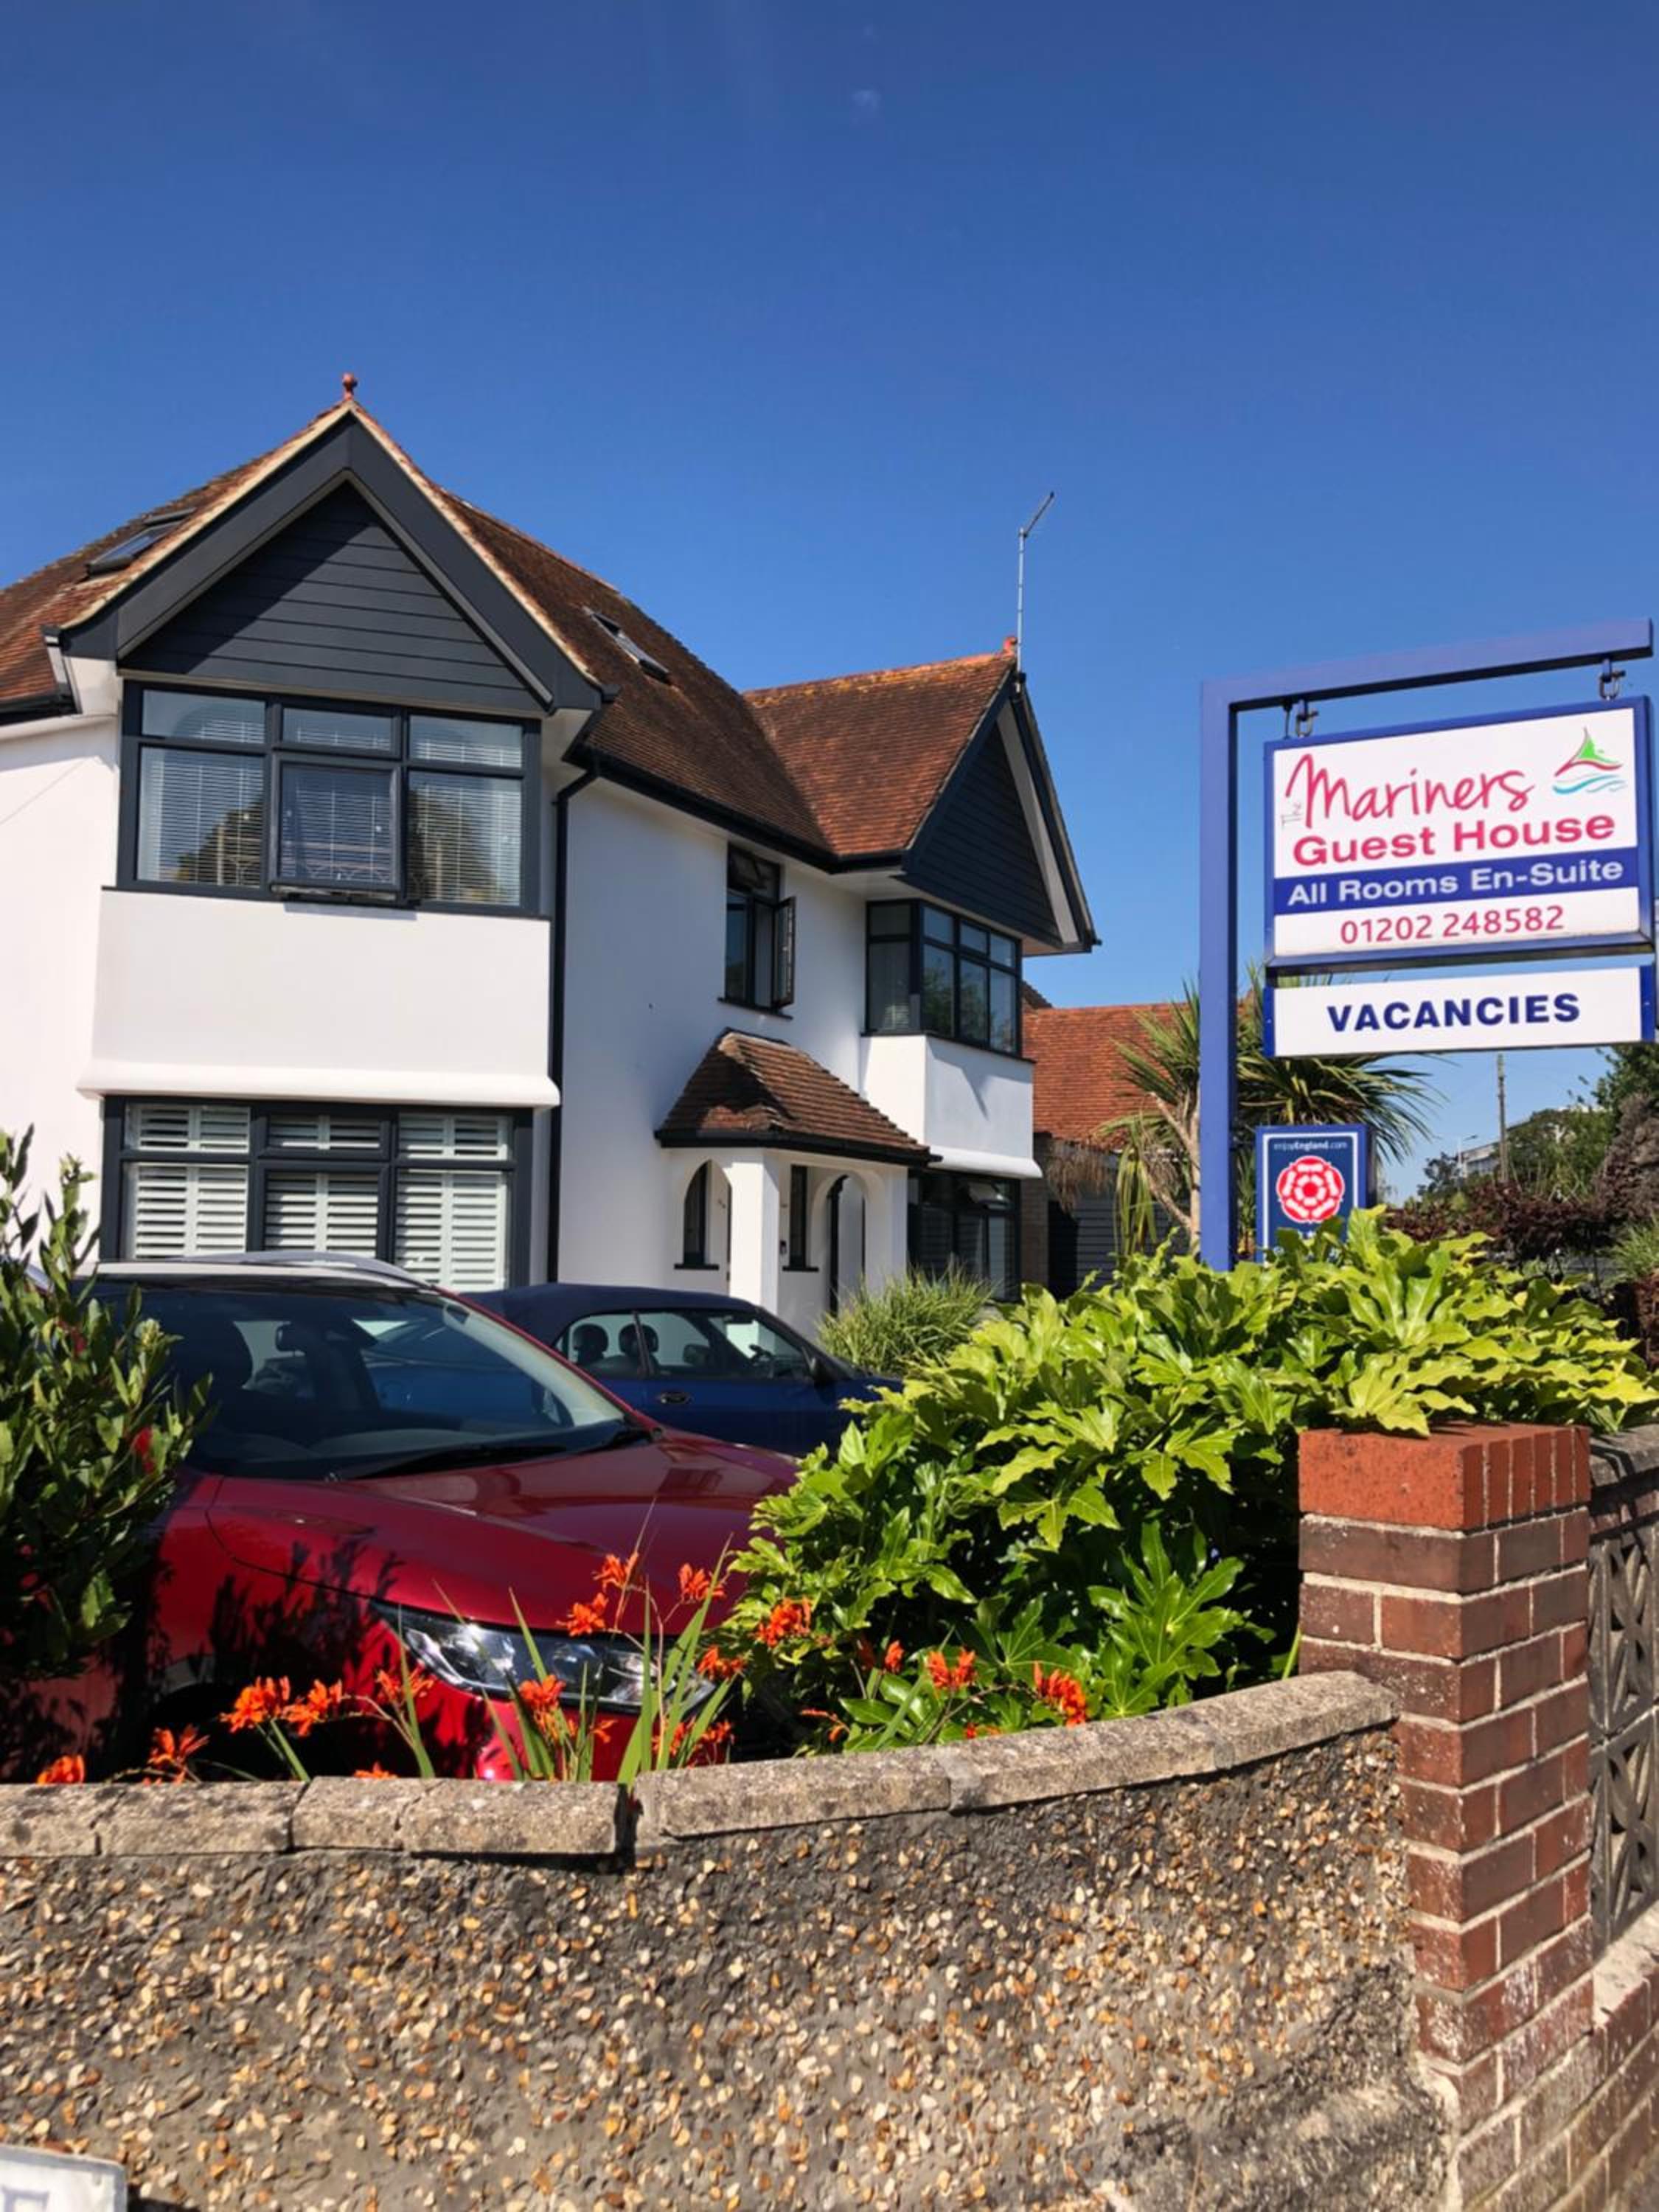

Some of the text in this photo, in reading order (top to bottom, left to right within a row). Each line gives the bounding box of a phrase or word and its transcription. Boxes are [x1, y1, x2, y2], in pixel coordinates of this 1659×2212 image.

[1285, 753, 1536, 829] Mariners
[1293, 814, 1615, 866] Guest House
[1287, 860, 1624, 906] All Rooms En-Suite
[1340, 905, 1565, 945] 01202 248582
[1327, 993, 1581, 1032] VACANCIES
